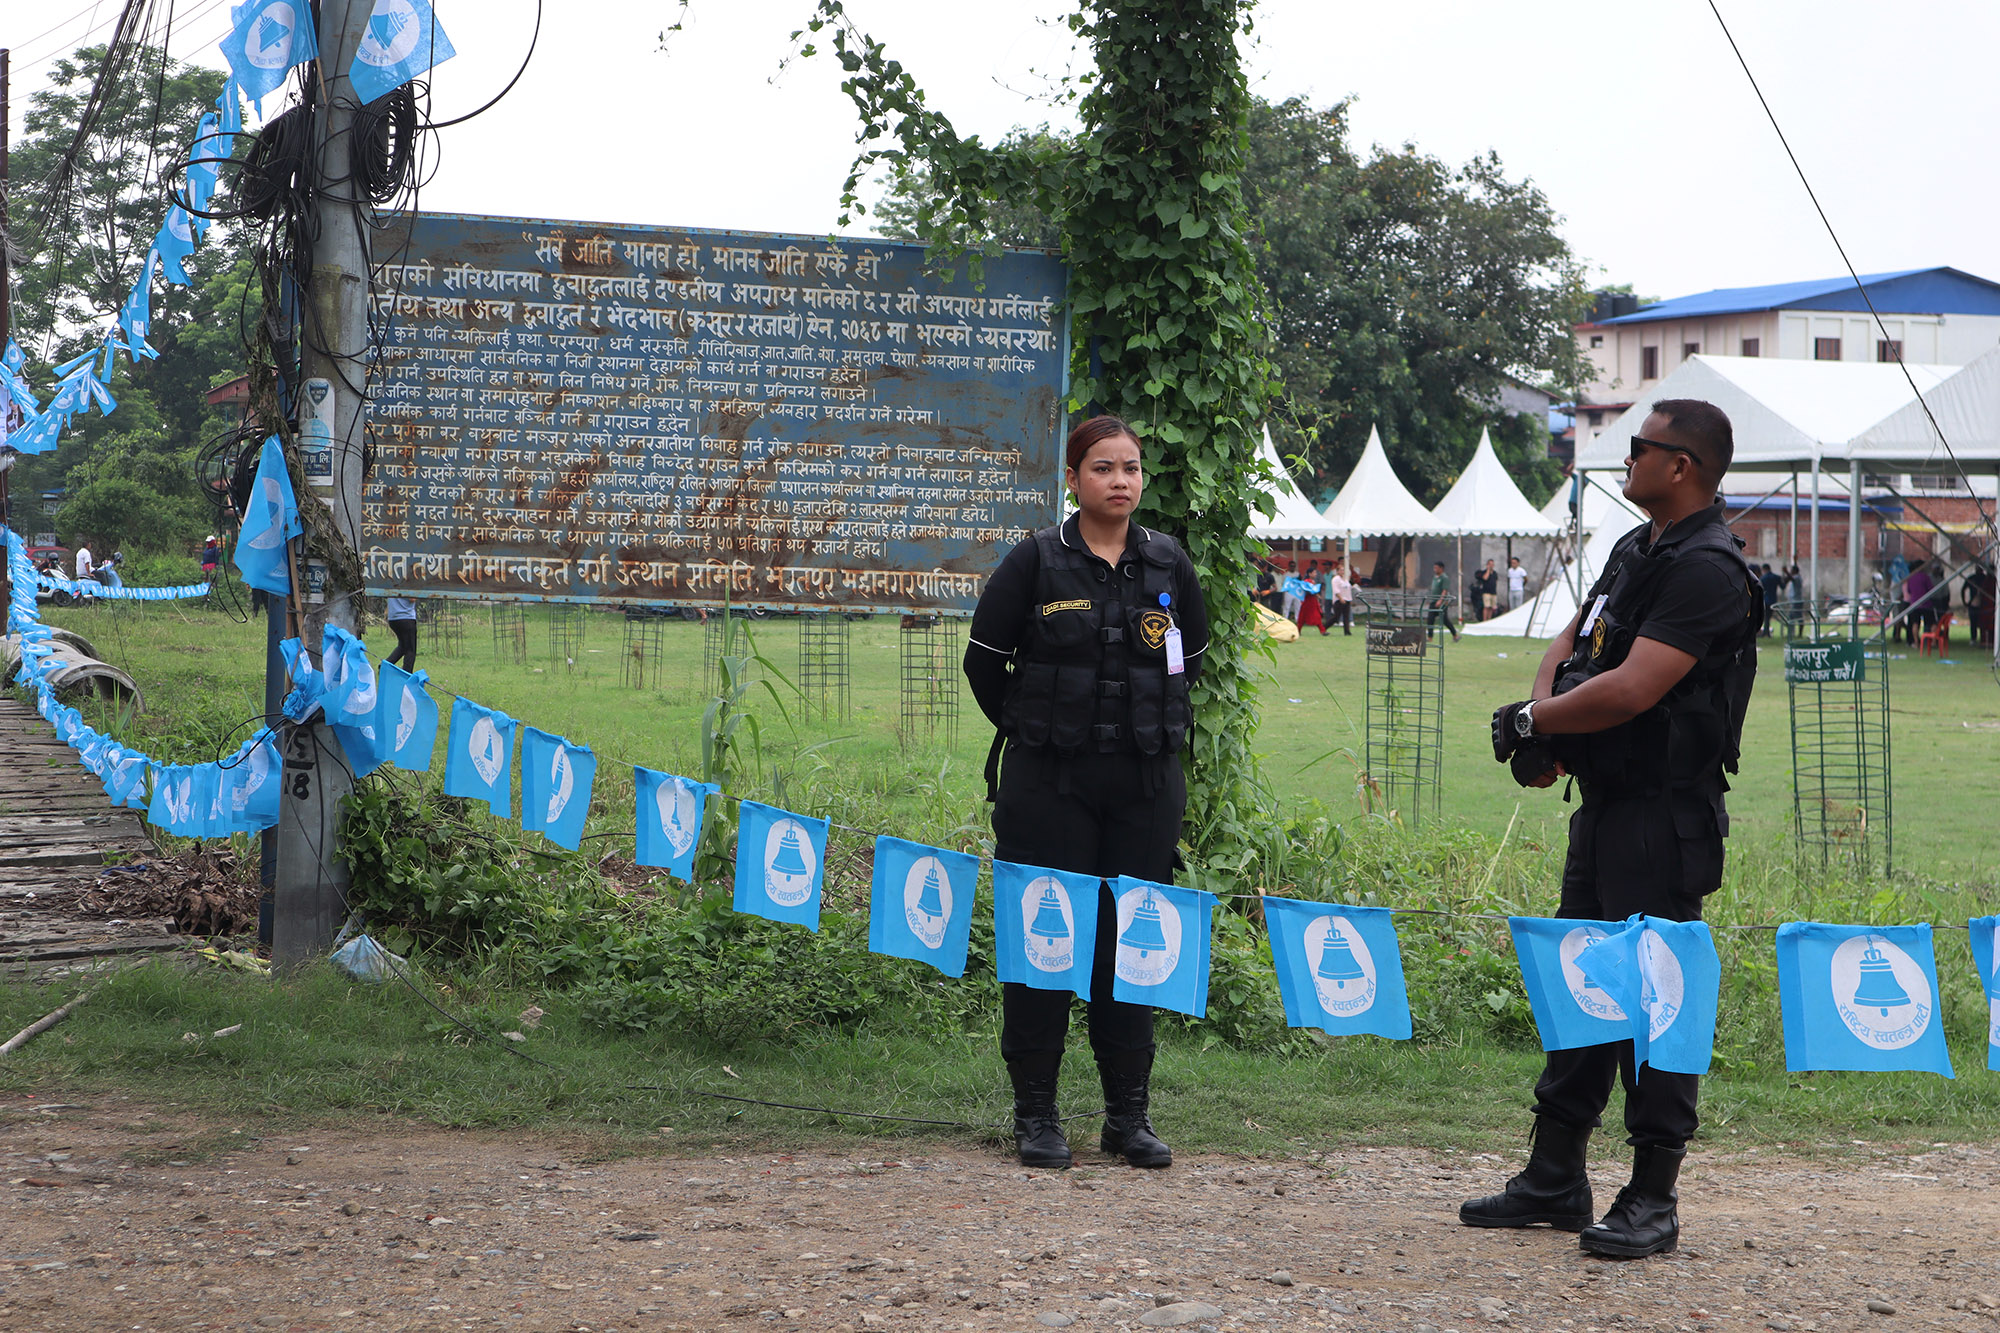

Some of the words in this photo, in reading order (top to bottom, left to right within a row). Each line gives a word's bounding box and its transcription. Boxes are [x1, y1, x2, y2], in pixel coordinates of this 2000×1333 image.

[571, 232, 615, 264] जाति
[622, 241, 671, 268] मानव
[712, 247, 762, 273] मानव
[763, 243, 808, 276] जाति
[443, 261, 542, 292] संविधानमा
[655, 273, 724, 303] दण्डनीय
[731, 284, 797, 307] अपराध
[802, 281, 859, 310] मानेको
[880, 292, 891, 313] र
[895, 286, 920, 314] सो
[922, 295, 985, 317] अपराध
[427, 297, 466, 321] तथा
[469, 299, 515, 323] अन्य
[590, 305, 602, 328] र
[607, 300, 676, 332] भेदभाव
[887, 321, 908, 344] मा
[916, 316, 972, 347] भएको
[394, 324, 418, 345] कुनै
[423, 325, 448, 344] पनि
[452, 327, 510, 349] व्यक्तिलाई
[610, 334, 632, 353] धर्म
[923, 353, 969, 369] व्यवसाय
[987, 353, 1035, 372] शारीरिक
[416, 348, 474, 363] आधारमा
[480, 348, 542, 366] सार्वजनिक
[564, 352, 592, 369] निजी
[598, 357, 644, 371] स्थानमा
[649, 356, 701, 374] देहायको
[707, 358, 734, 376] कार्य
[738, 360, 760, 377] गर्न
[425, 364, 484, 383] उपस्थिति
[513, 372, 525, 386] वा
[528, 373, 553, 387] भाग
[559, 370, 585, 388] लिन
[590, 372, 626, 390] निषेध
[688, 376, 741, 395] नियन्त्रण
[821, 383, 867, 401] लगाउने
[380, 401, 422, 419] धार्मिक
[429, 403, 457, 420] कार्य
[605, 415, 651, 429] गराउन
[426, 387, 457, 401] स्थान
[689, 399, 702, 413] वा
[770, 403, 818, 418] व्यवहार
[823, 402, 867, 420] प्रदर्शन
[896, 405, 932, 423] गरेमा
[572, 428, 612, 447] भएको
[615, 430, 695, 450] अन्तरजातीय
[700, 434, 737, 452] विवाह
[768, 437, 792, 454] रोक
[851, 440, 891, 459] त्यस्तो
[385, 461, 417, 478] पाउने
[503, 466, 555, 484] नजिकको
[679, 474, 706, 490] दलित
[748, 477, 776, 493] जिल्ला
[780, 481, 819, 495] प्रशासन
[917, 487, 942, 501] तहमा
[943, 485, 966, 502] समेत
[465, 449, 521, 463] नगराउन
[607, 451, 646, 468] विवाह
[698, 458, 739, 472] गराउन
[743, 457, 767, 475] कुनै
[773, 459, 835, 476] किसिमको
[840, 464, 862, 477] कर
[929, 468, 973, 482] लगाउन
[398, 484, 422, 498] यस
[428, 483, 465, 499] ऐनको
[611, 490, 670, 507] महिनादेखि
[674, 496, 681, 508] ३
[415, 505, 447, 518] मद्दत
[472, 524, 534, 542] सार्वजनिक
[539, 529, 562, 543] पद
[567, 530, 605, 545] धारण
[609, 529, 648, 547] गरेको
[737, 534, 782, 552] प्रतिशत
[786, 539, 806, 553] थप
[413, 552, 452, 579] तथा
[458, 549, 571, 588] सीमान्तकृत
[577, 553, 610, 586] वर्ग
[614, 560, 678, 588] उत्थान
[765, 566, 836, 599] भरतपुर
[840, 564, 982, 599] महानगरपालिका
[1840, 1002, 1871, 1038] राष्ट्रिय
[1873, 1023, 1915, 1043] स्वतन्त्र
[1912, 1002, 1930, 1029] पार्टी
